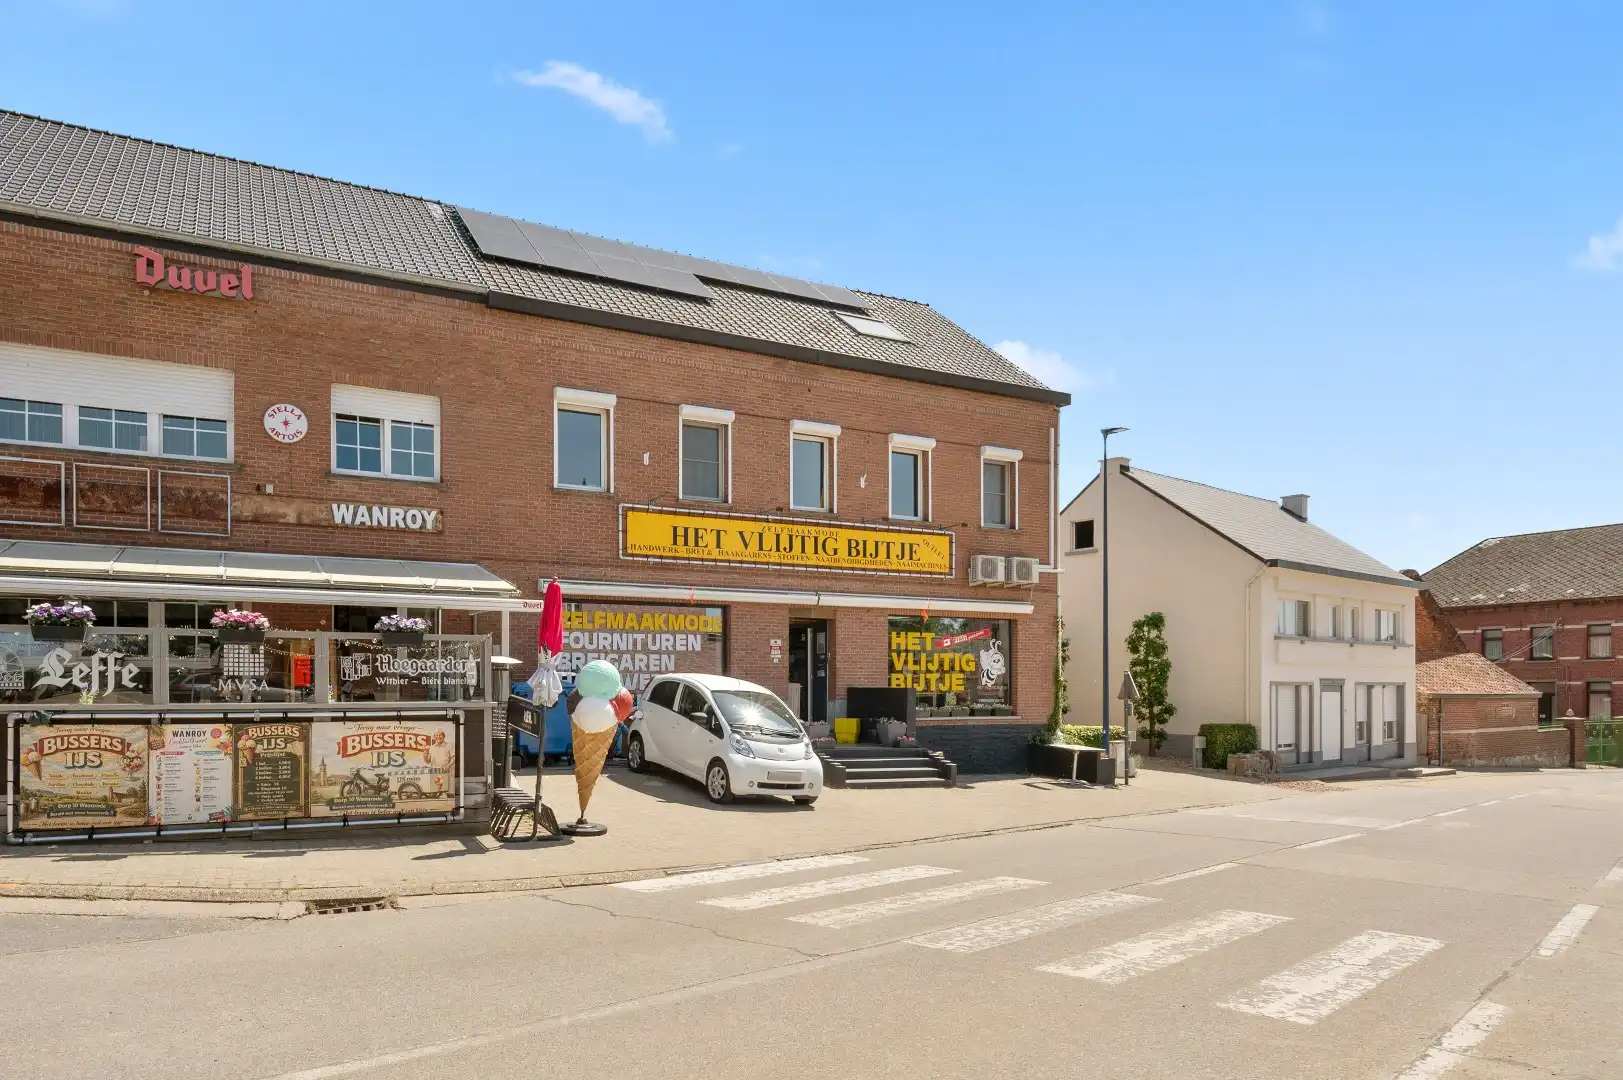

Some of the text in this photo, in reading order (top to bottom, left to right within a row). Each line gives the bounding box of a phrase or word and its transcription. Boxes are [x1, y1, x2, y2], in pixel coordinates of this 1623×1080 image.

[135, 245, 254, 300] Duvel
[268, 406, 302, 420] STELLA
[269, 427, 302, 440] ARTOIS
[331, 503, 437, 530] WANROY
[761, 525, 840, 537] ZELFMAAKMODE
[671, 525, 921, 561] HET VLIJTIG BIJTJE
[922, 538, 946, 560] OUTLET
[685, 547, 704, 556] BREI
[718, 549, 771, 559] HAAKGARENS
[562, 611, 722, 632] ZELFMAAKMODE
[562, 632, 701, 651] FOURNITUREN
[891, 631, 935, 650] HET
[891, 653, 976, 672] VLIJTIG
[375, 677, 409, 685] Witbier
[443, 676, 468, 685] blanch
[890, 673, 965, 691] BIJTJE
[172, 730, 207, 738] WANROY
[248, 725, 300, 739] BUSSERS
[43, 735, 122, 755] BUSSERS
[262, 738, 286, 750] IJS
[347, 733, 428, 754] BUSSERS
[64, 751, 103, 769] IJS
[370, 750, 407, 767] IJS
